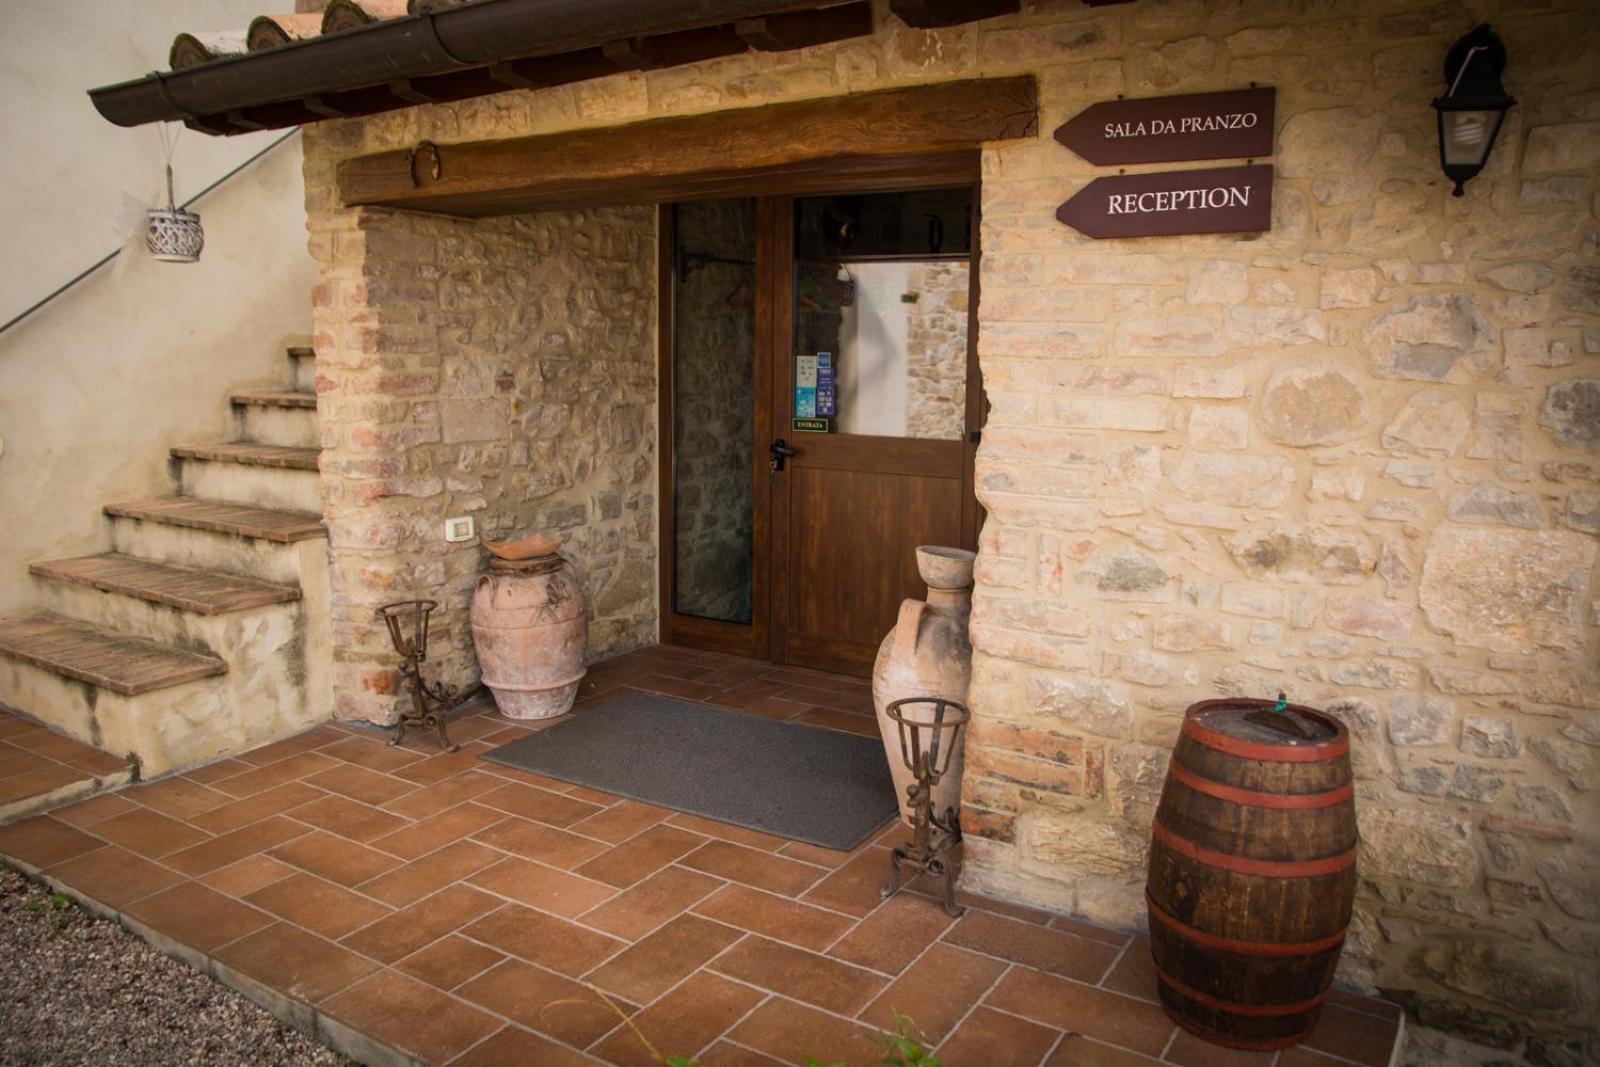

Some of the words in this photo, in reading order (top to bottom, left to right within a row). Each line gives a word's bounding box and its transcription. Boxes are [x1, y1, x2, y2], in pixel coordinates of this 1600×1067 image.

[1105, 121, 1147, 138] SALA
[1151, 119, 1176, 135] DA
[1180, 112, 1258, 133] PRANZO
[1107, 185, 1251, 215] RECEPTION
